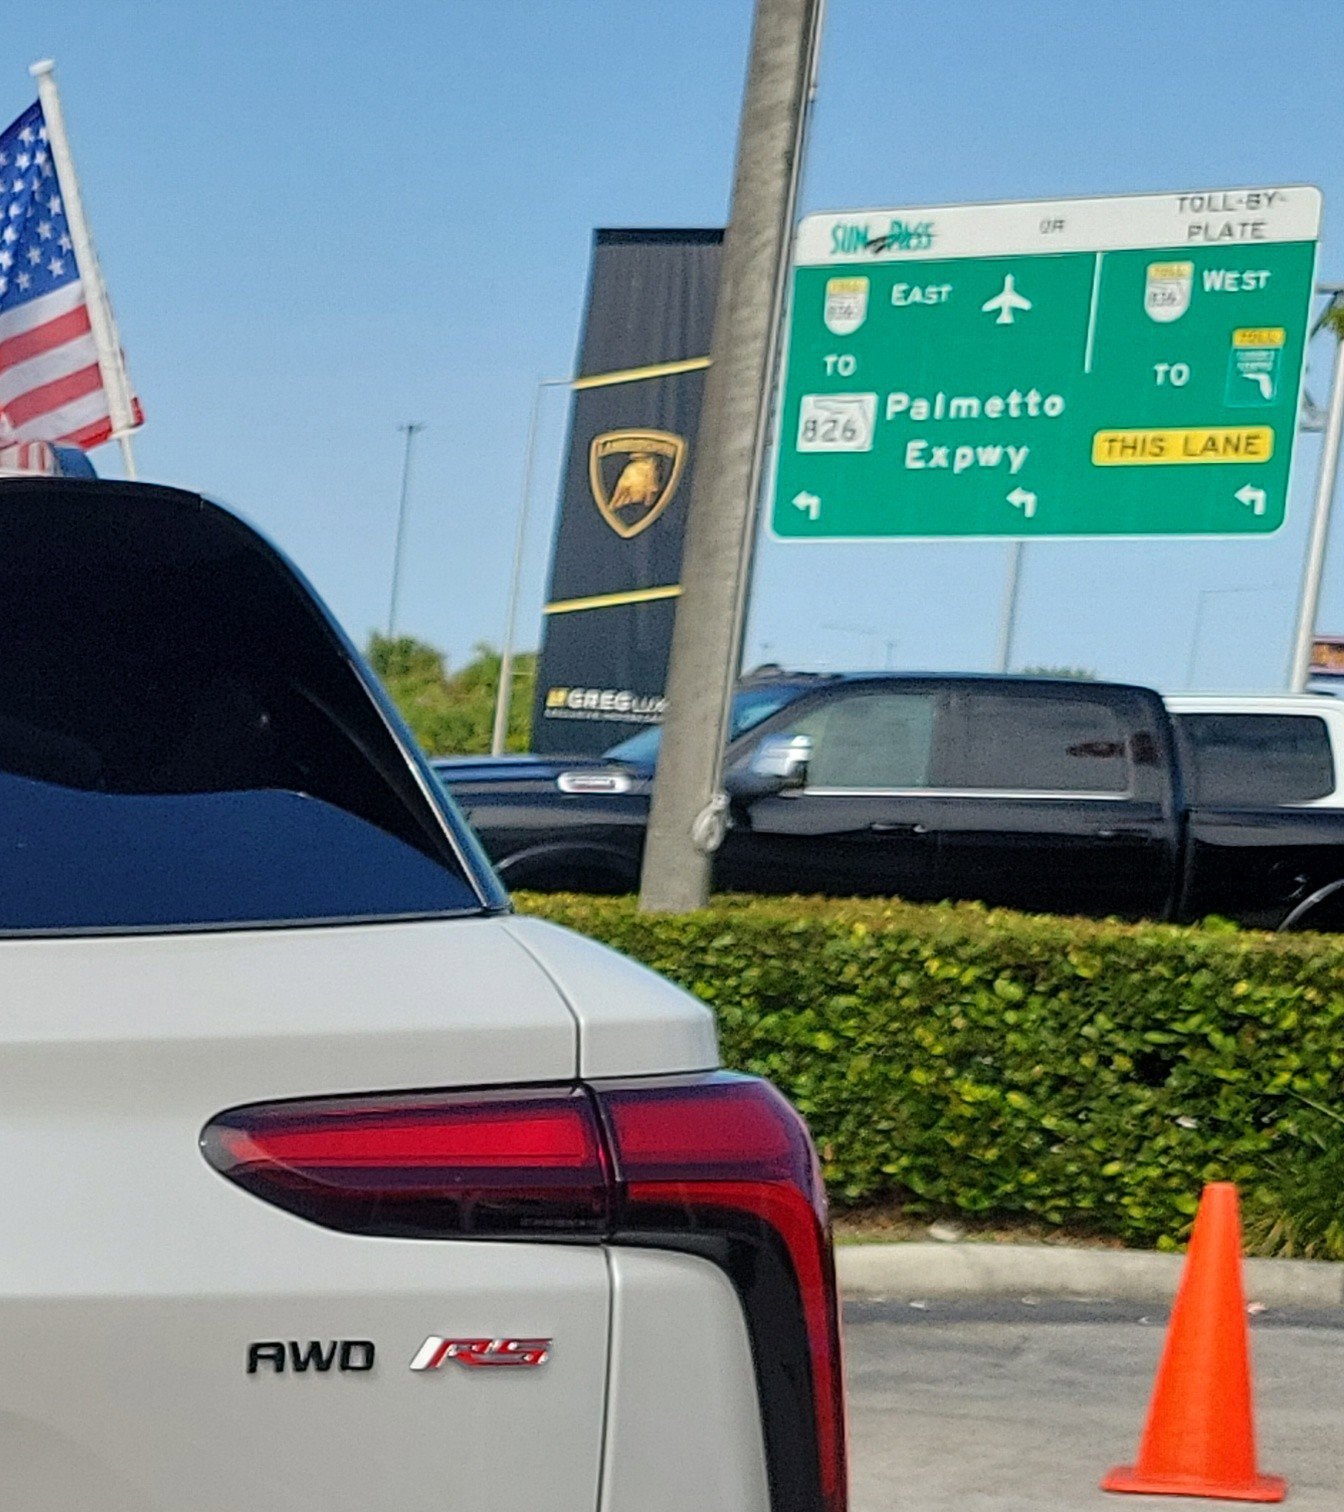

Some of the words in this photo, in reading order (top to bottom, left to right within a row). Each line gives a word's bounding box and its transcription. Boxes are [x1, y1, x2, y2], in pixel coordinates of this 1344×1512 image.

[1187, 220, 1268, 241] PLATE
[1202, 269, 1272, 292] WEST
[891, 282, 953, 306] EAST
[823, 354, 857, 377] TO
[1153, 362, 1191, 387] TO
[885, 387, 1066, 421] Palmetto
[802, 418, 857, 443] 826
[904, 438, 1031, 475] Expwy
[1103, 435, 1166, 458] THIS
[1182, 433, 1263, 457] LANE
[247, 1340, 375, 1373] AWD
[410, 1335, 554, 1370] RS
